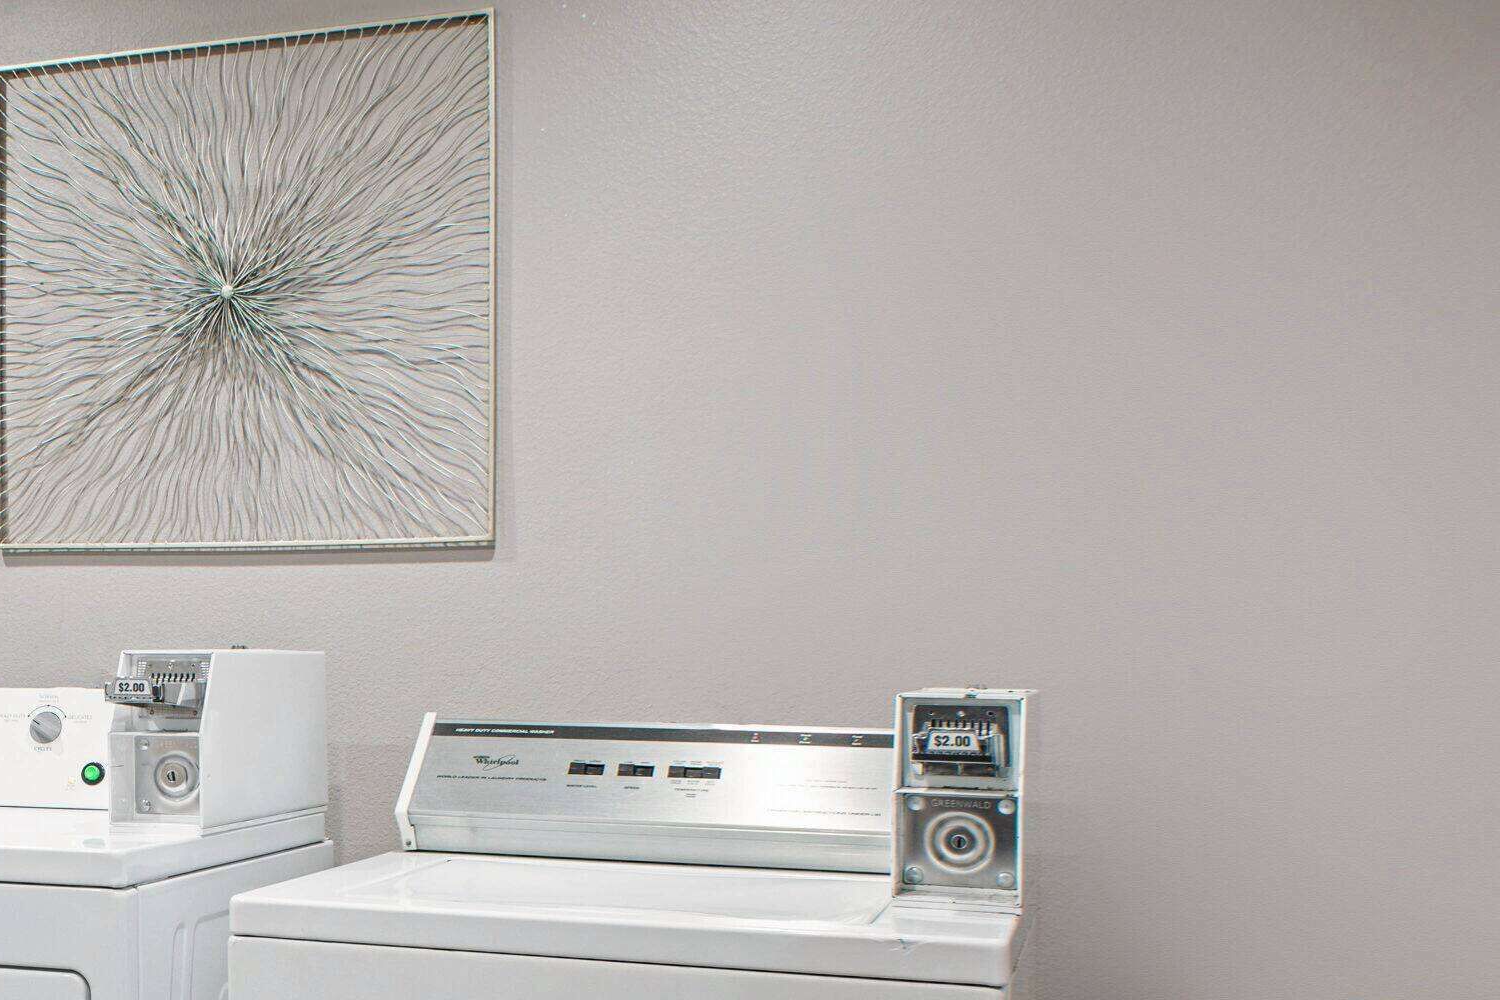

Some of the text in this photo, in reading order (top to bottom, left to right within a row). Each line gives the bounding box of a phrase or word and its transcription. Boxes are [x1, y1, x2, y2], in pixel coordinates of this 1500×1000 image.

[118, 682, 145, 693] $2.00
[933, 735, 971, 747] $2.00
[474, 757, 519, 766] Whirlpool
[931, 799, 992, 809] GREENWALD
